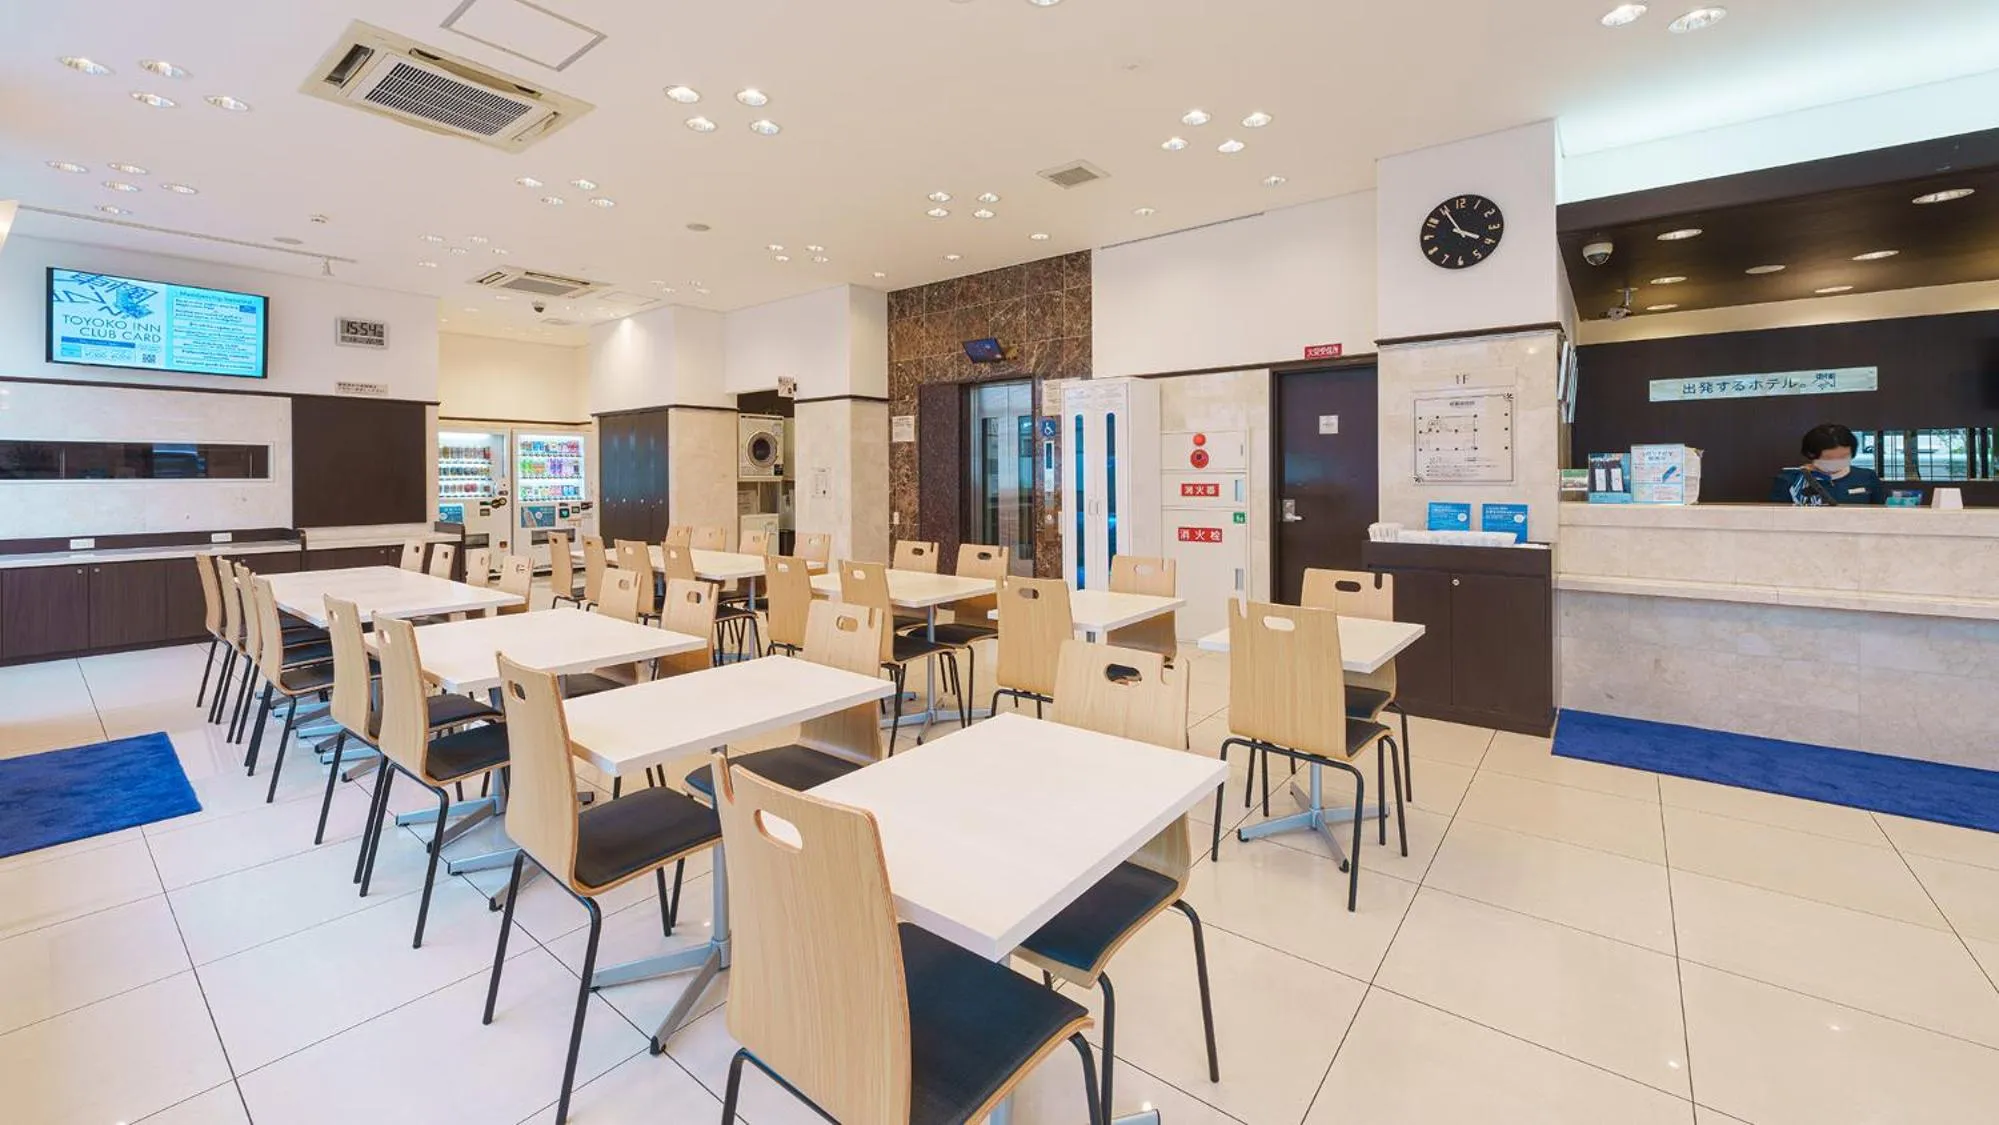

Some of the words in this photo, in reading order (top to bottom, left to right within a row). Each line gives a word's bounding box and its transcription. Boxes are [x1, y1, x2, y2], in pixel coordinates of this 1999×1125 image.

[1456, 198, 1466, 209] 12
[1474, 199, 1481, 209] 1
[1484, 208, 1495, 218] 2
[1441, 254, 1449, 264] 7
[1473, 249, 1482, 259] 5
[1457, 256, 1464, 265] 6
[63, 314, 127, 330] TOYOKO
[133, 322, 161, 333] INN
[79, 327, 117, 339] CLUB
[122, 331, 161, 343] CARD
[1455, 374, 1470, 385] 1F
